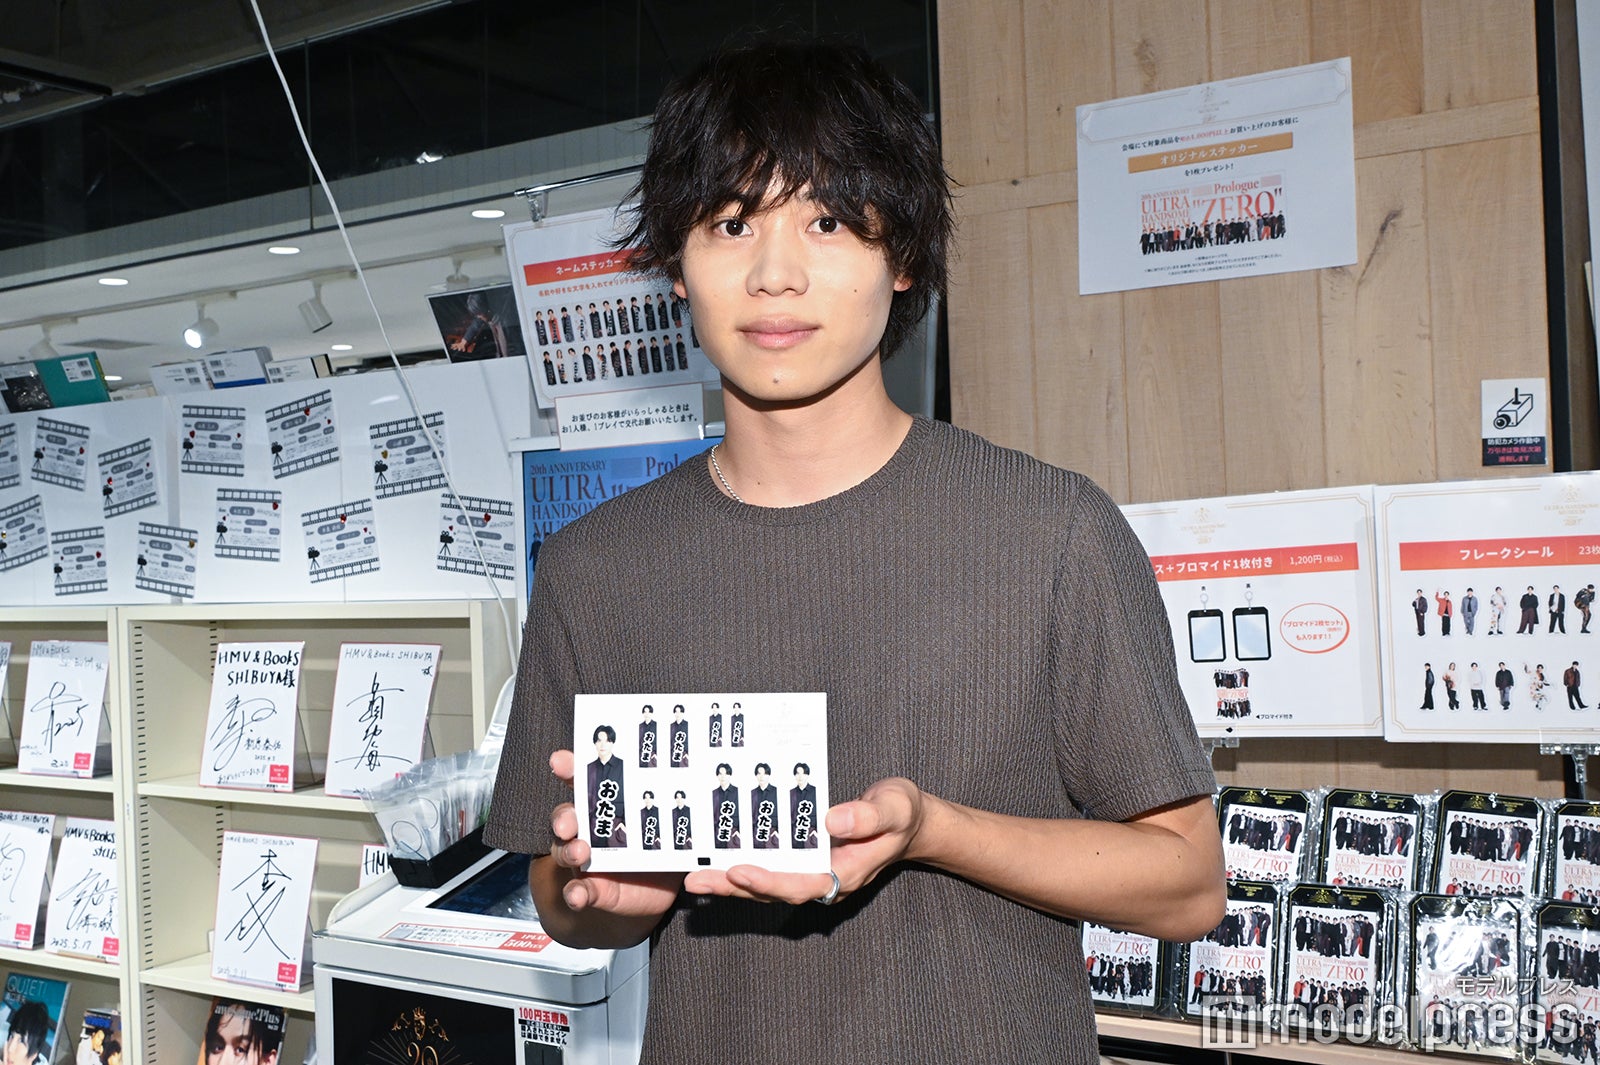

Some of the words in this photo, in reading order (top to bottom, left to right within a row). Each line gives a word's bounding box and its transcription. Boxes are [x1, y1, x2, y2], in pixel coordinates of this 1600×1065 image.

[1160, 143, 1258, 165] オリジナルステッカー
[1214, 180, 1259, 195] Prologue
[1141, 194, 1190, 215] ULTRA
[1141, 208, 1189, 223] HANDSOME
[555, 258, 622, 275] ネームステッカー
[571, 403, 690, 423] お並びのお客様がいらっしゃるときは
[529, 462, 547, 475] 20th
[549, 459, 607, 472] ANNIVERSARY
[645, 453, 681, 477] Prol
[531, 474, 607, 502] ULTRA
[1459, 545, 1554, 560] フレークシール
[711, 721, 721, 744] おたま
[732, 721, 742, 744] おたま
[641, 731, 655, 763] おたま
[672, 731, 686, 763] おたま
[596, 780, 618, 837] おたま
[644, 816, 657, 845] おたま
[676, 816, 688, 845] おたま
[717, 800, 735, 843] おたま
[756, 800, 774, 842] おたま
[795, 800, 813, 842] おたま
[519, 1007, 568, 1025] 100円玉専用
